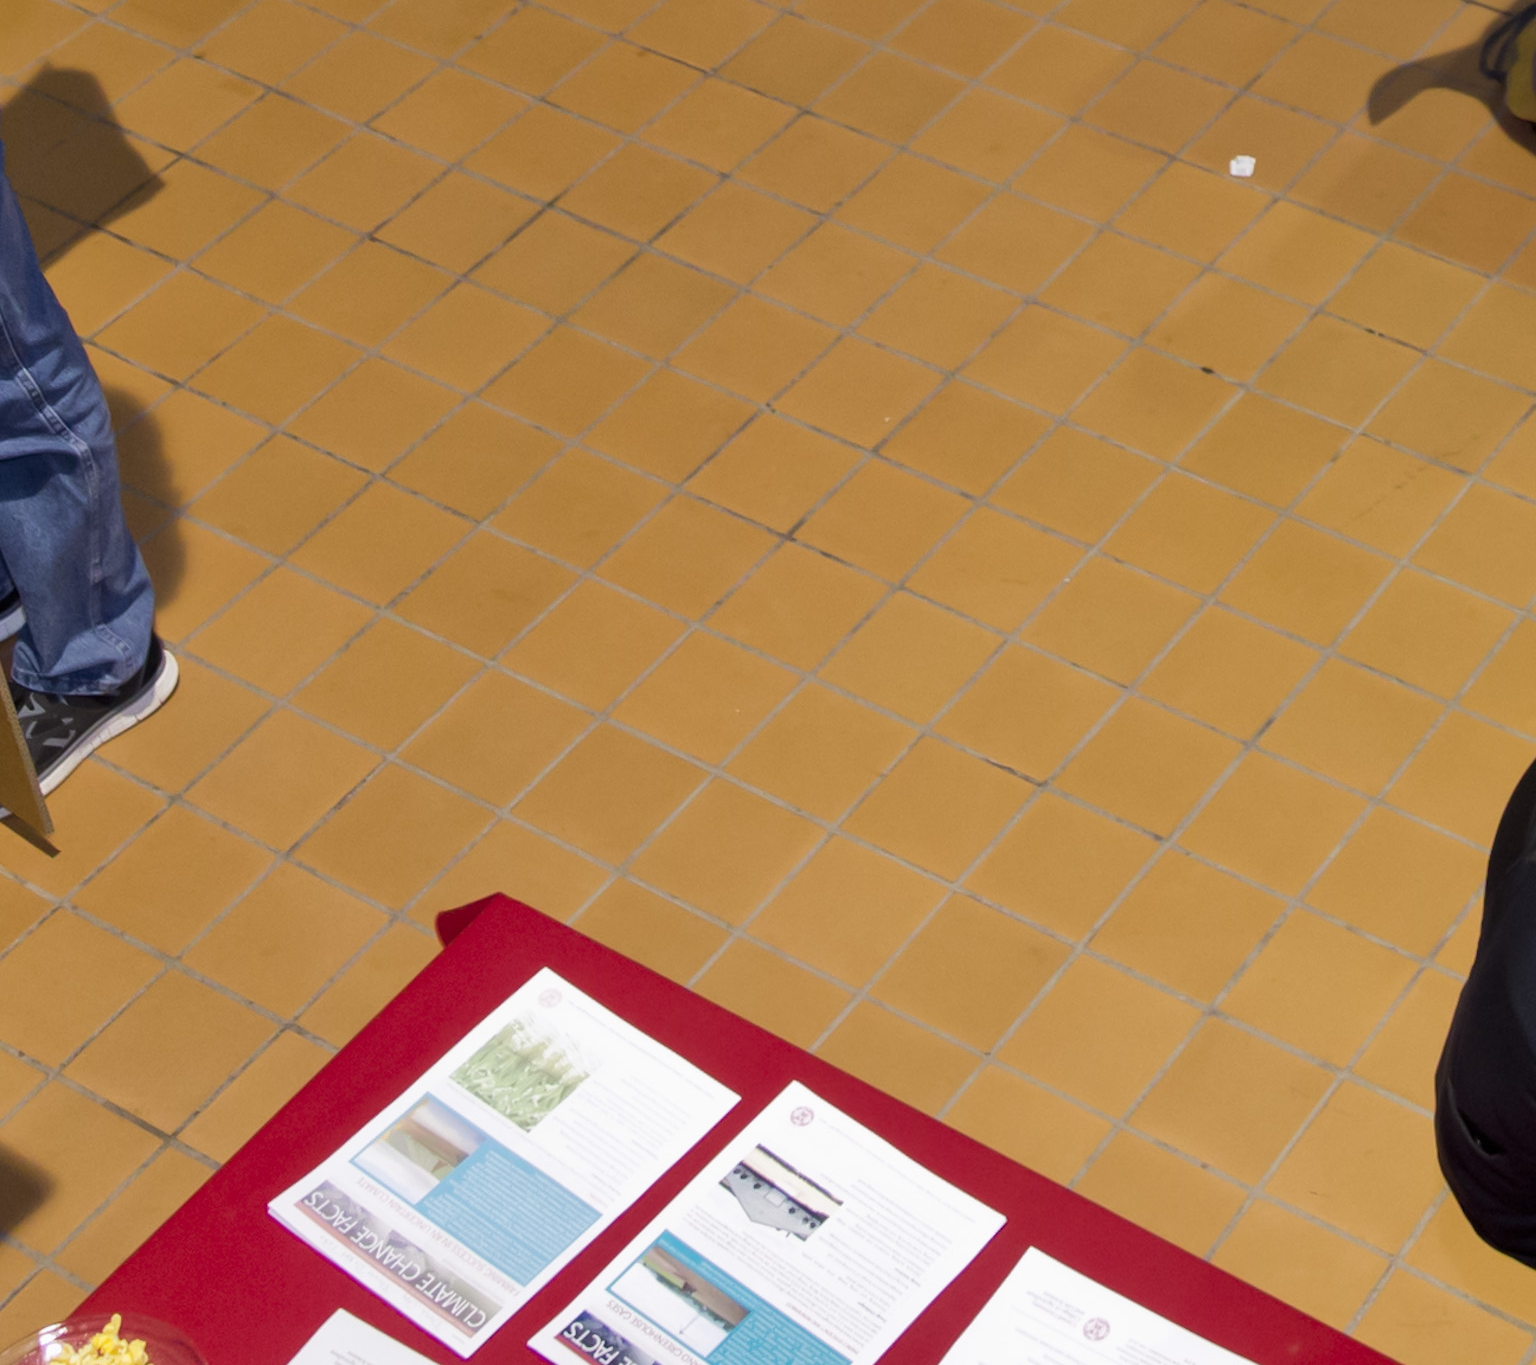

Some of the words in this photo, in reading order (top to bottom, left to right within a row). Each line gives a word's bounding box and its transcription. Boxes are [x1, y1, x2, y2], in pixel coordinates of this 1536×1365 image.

[302, 1188, 359, 1239] FACTS
[356, 1175, 391, 1206] CLIMATE
[349, 1219, 422, 1285] CHANGE
[419, 1270, 489, 1329] CLIMATE
[605, 1299, 633, 1325] GASES
[562, 1319, 621, 1365] FACTS
[627, 1311, 684, 1359] GREENHOUSE
